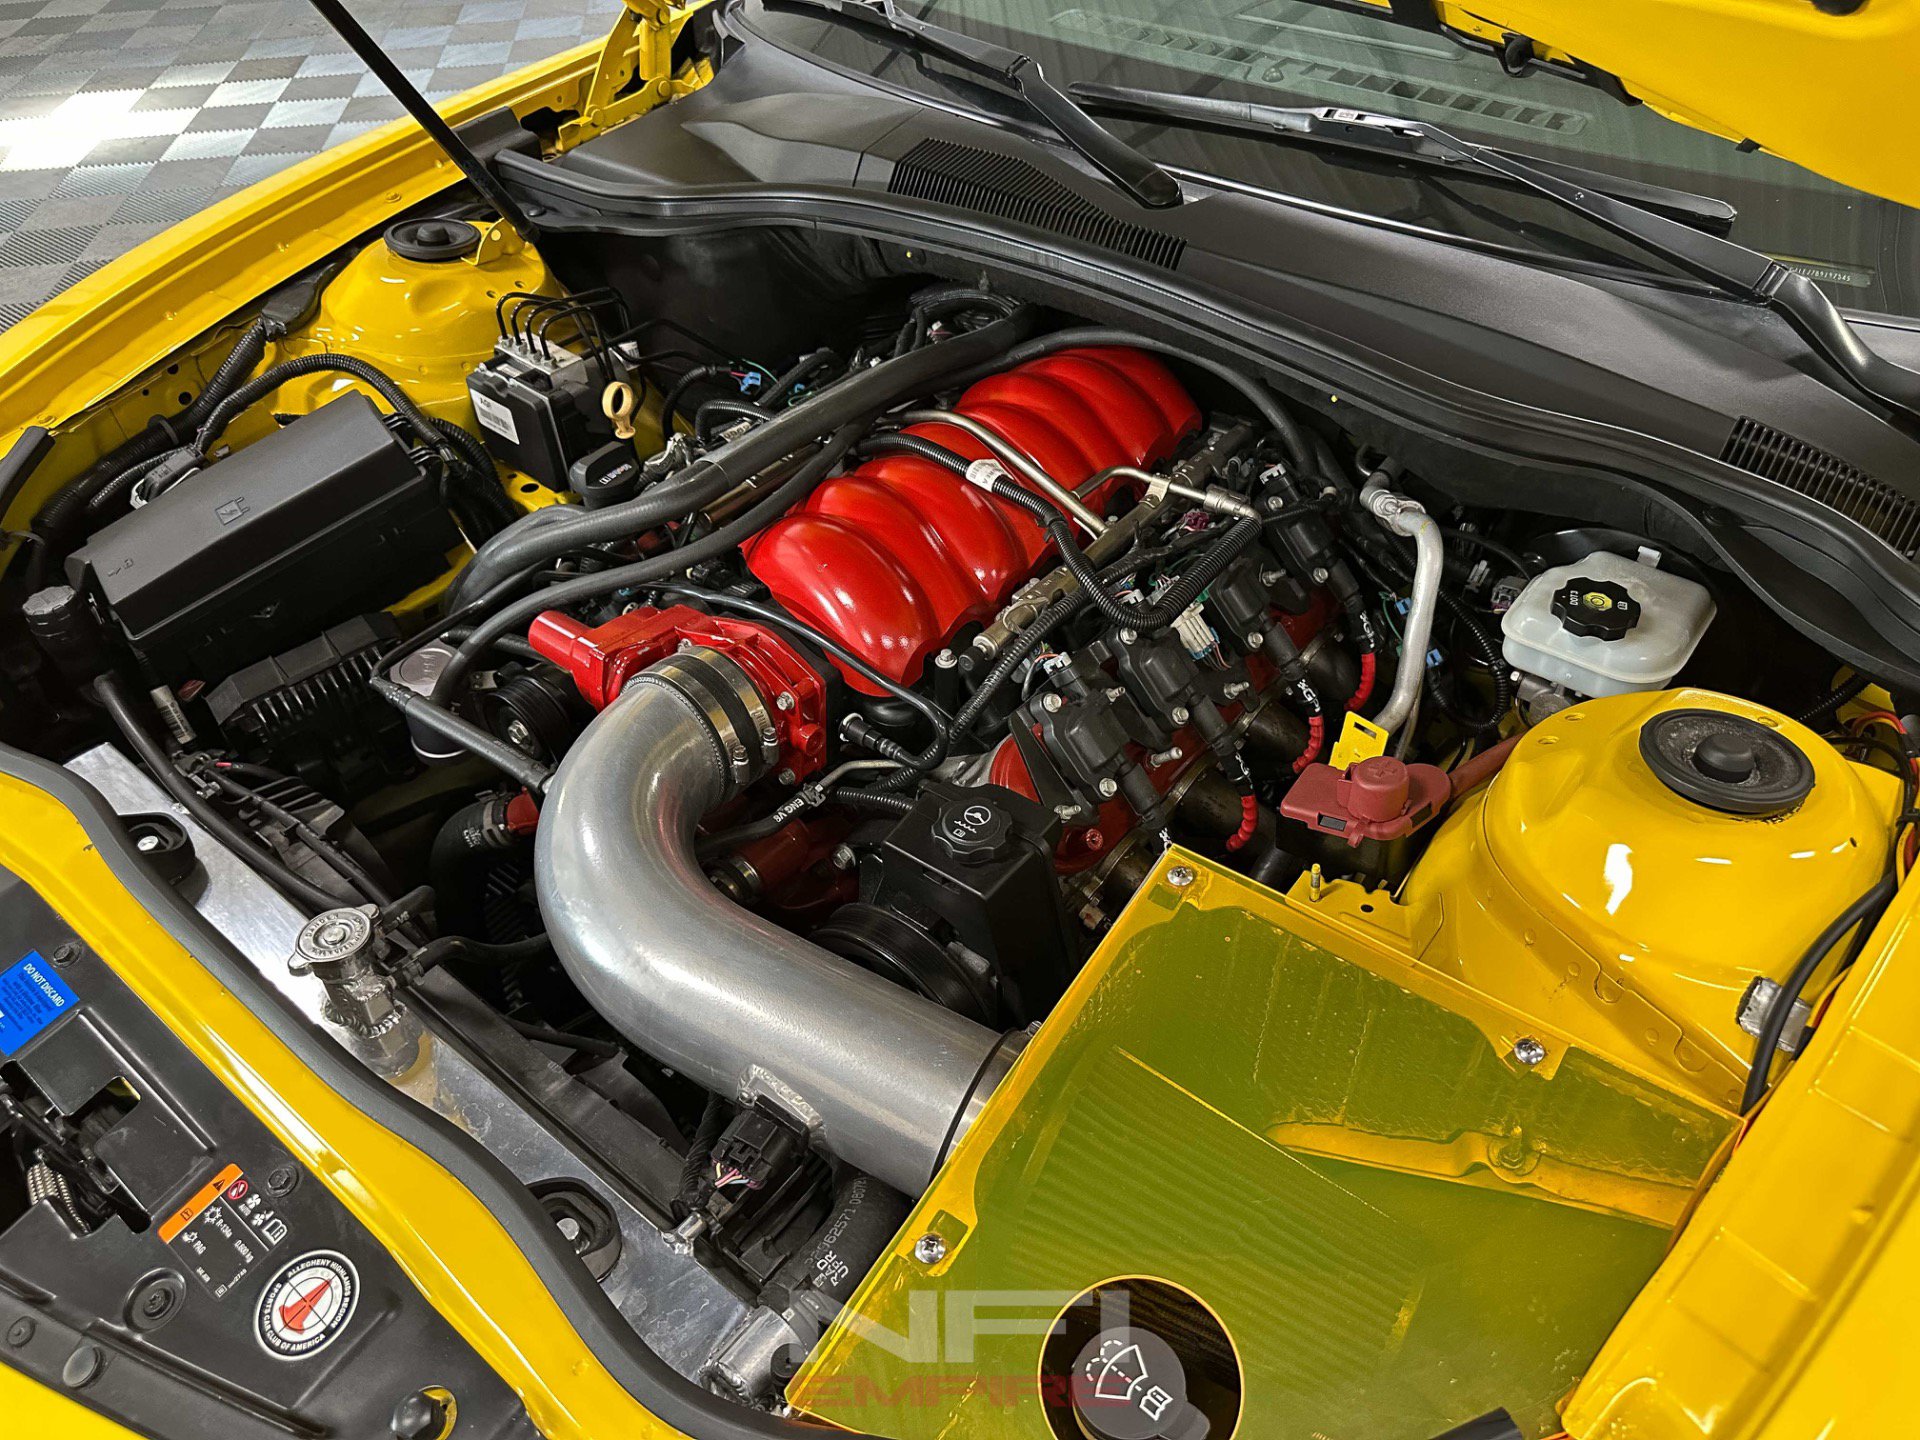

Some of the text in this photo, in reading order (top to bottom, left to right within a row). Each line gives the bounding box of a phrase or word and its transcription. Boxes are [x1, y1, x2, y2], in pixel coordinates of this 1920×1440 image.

[784, 798, 804, 813] ENG
[23, 963, 65, 1007] DO NOT DISCARD
[193, 1240, 206, 1255] PAG
[287, 1258, 332, 1278] ALLEGHENY
[330, 1260, 352, 1297] HIGHLANDS
[263, 1282, 327, 1352] SPORTS CAR CLUB OF AMERICA
[330, 1297, 351, 1329] REGION
